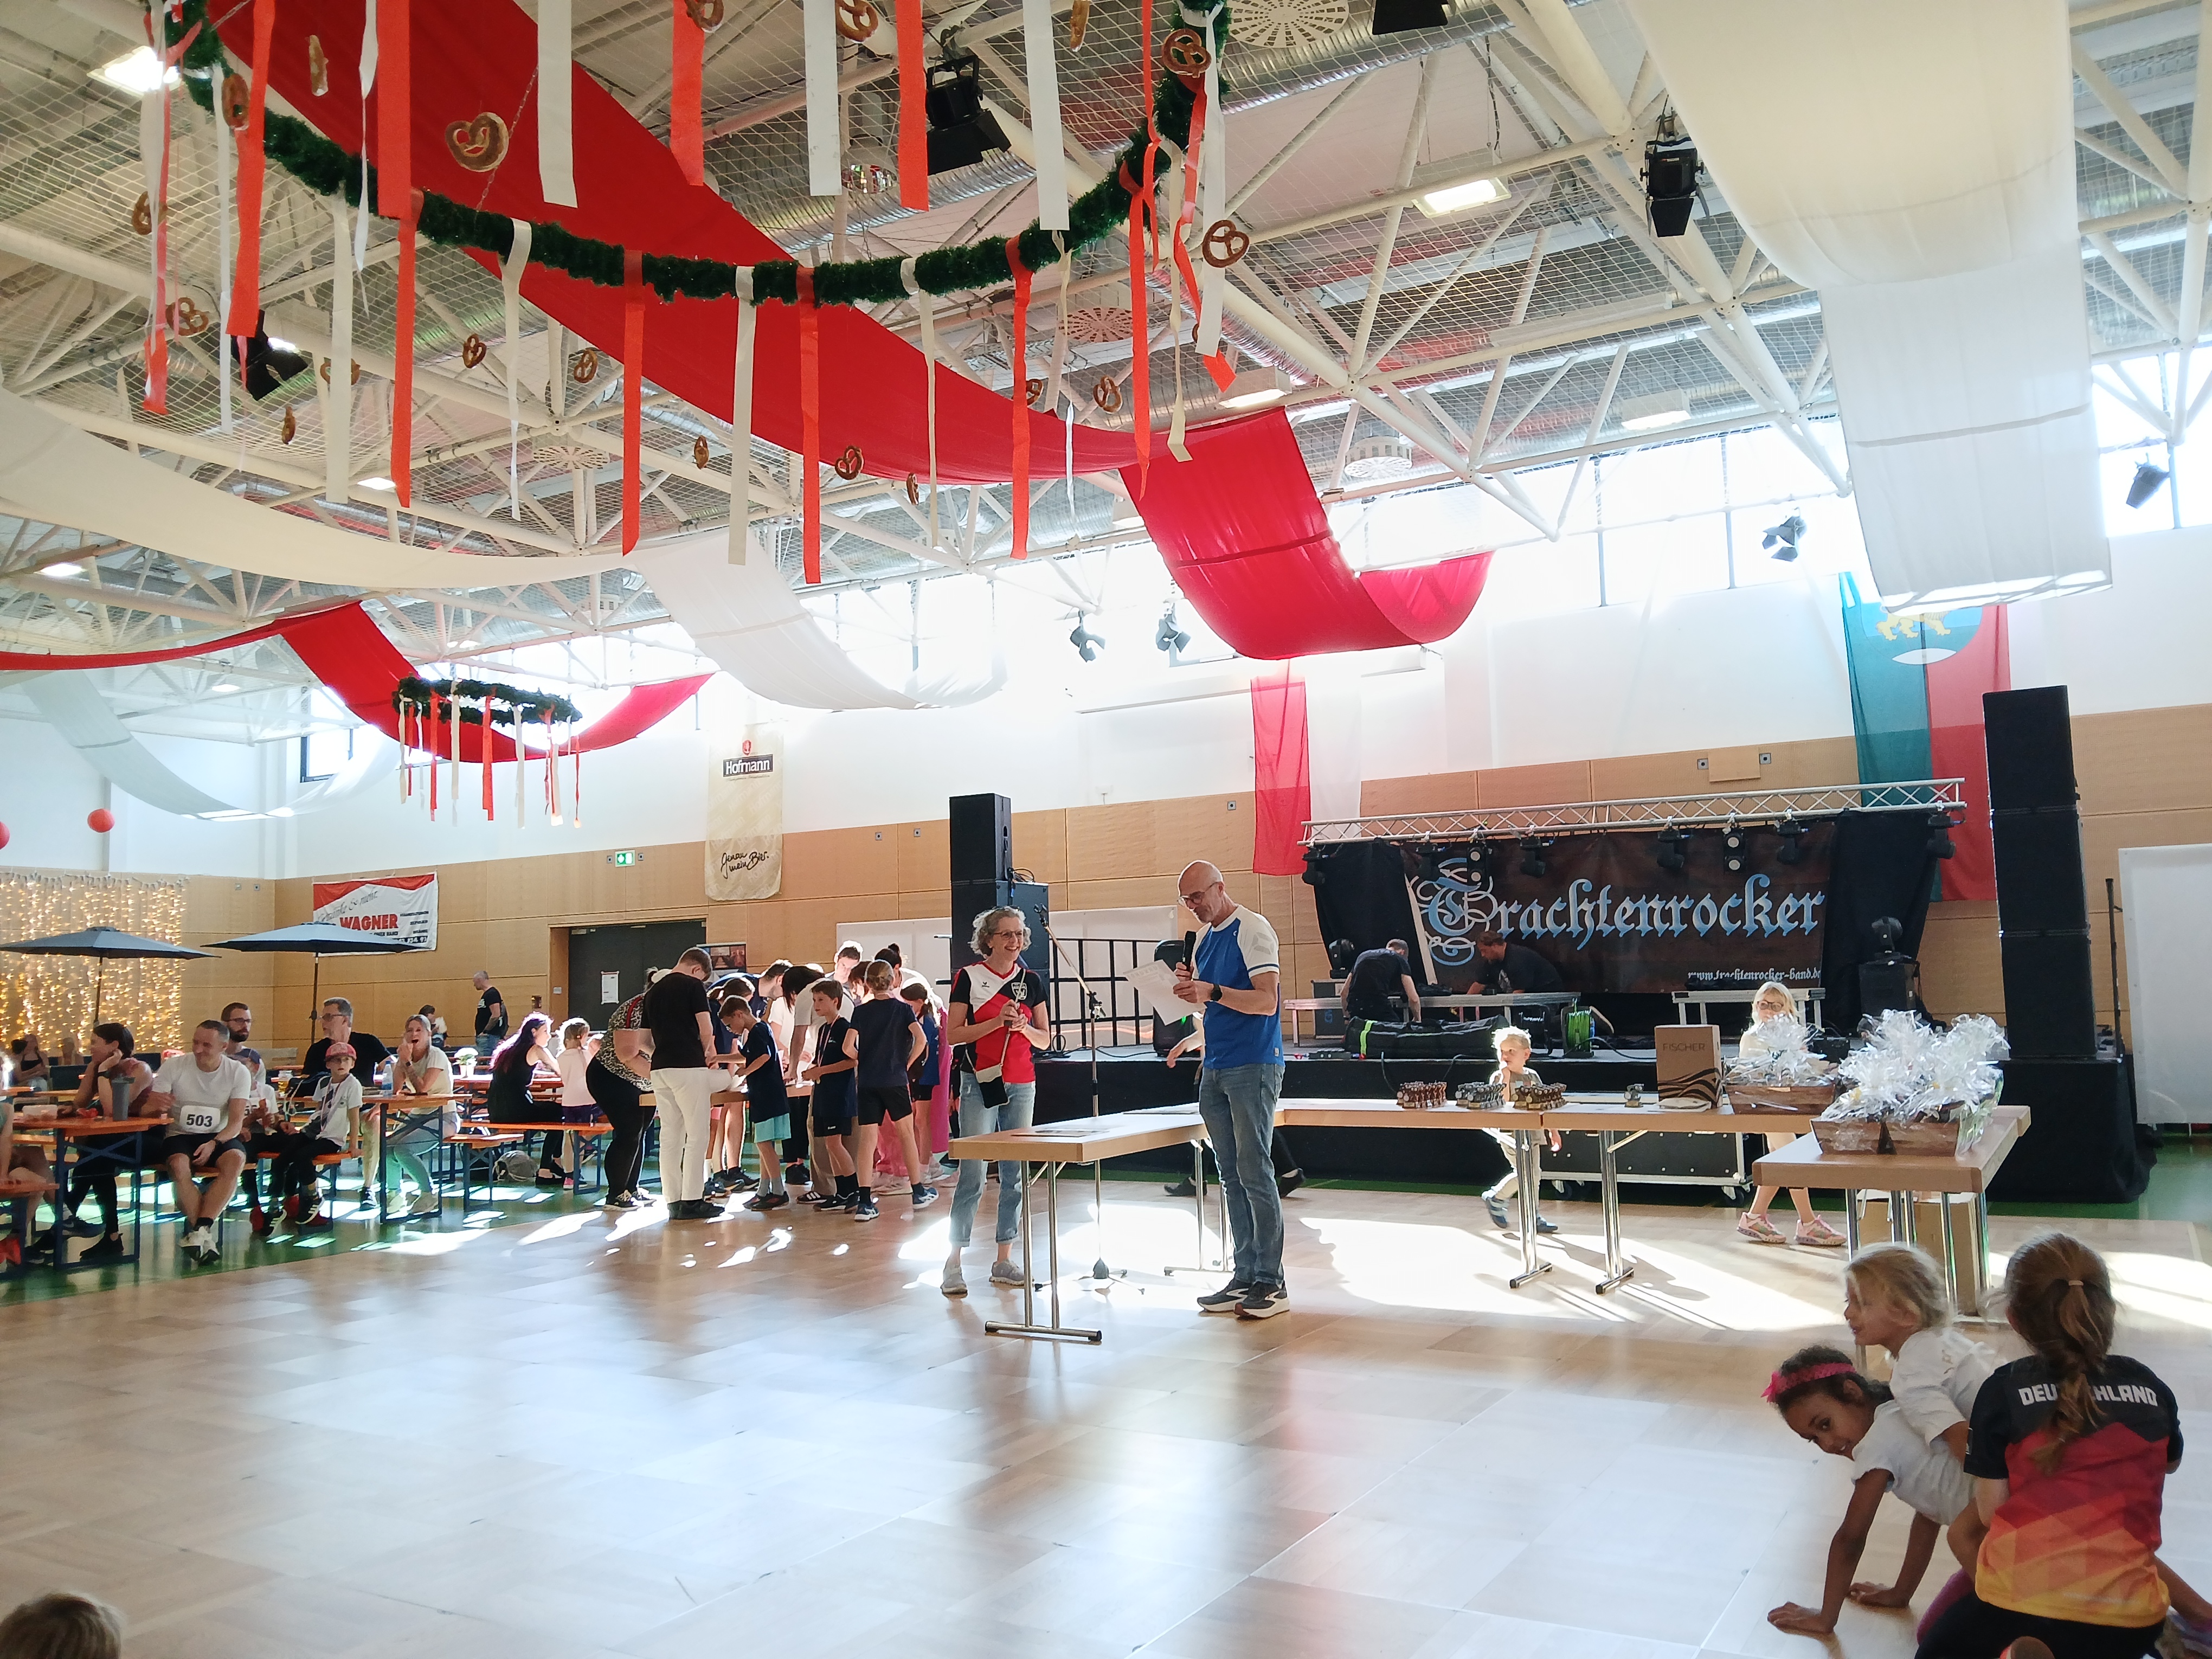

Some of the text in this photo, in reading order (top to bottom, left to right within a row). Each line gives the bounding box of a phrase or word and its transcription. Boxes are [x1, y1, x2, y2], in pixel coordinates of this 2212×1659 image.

[726, 759, 770, 775] Hofmann
[721, 852, 748, 879] Genau
[729, 851, 769, 872] mein Bier.
[1419, 858, 1825, 966] Trachtenrocker
[339, 914, 398, 931] WAGNER
[1662, 1043, 1706, 1051] FISCHER
[186, 1114, 213, 1127] 503
[2018, 1383, 2158, 1407] DEUHLAND
